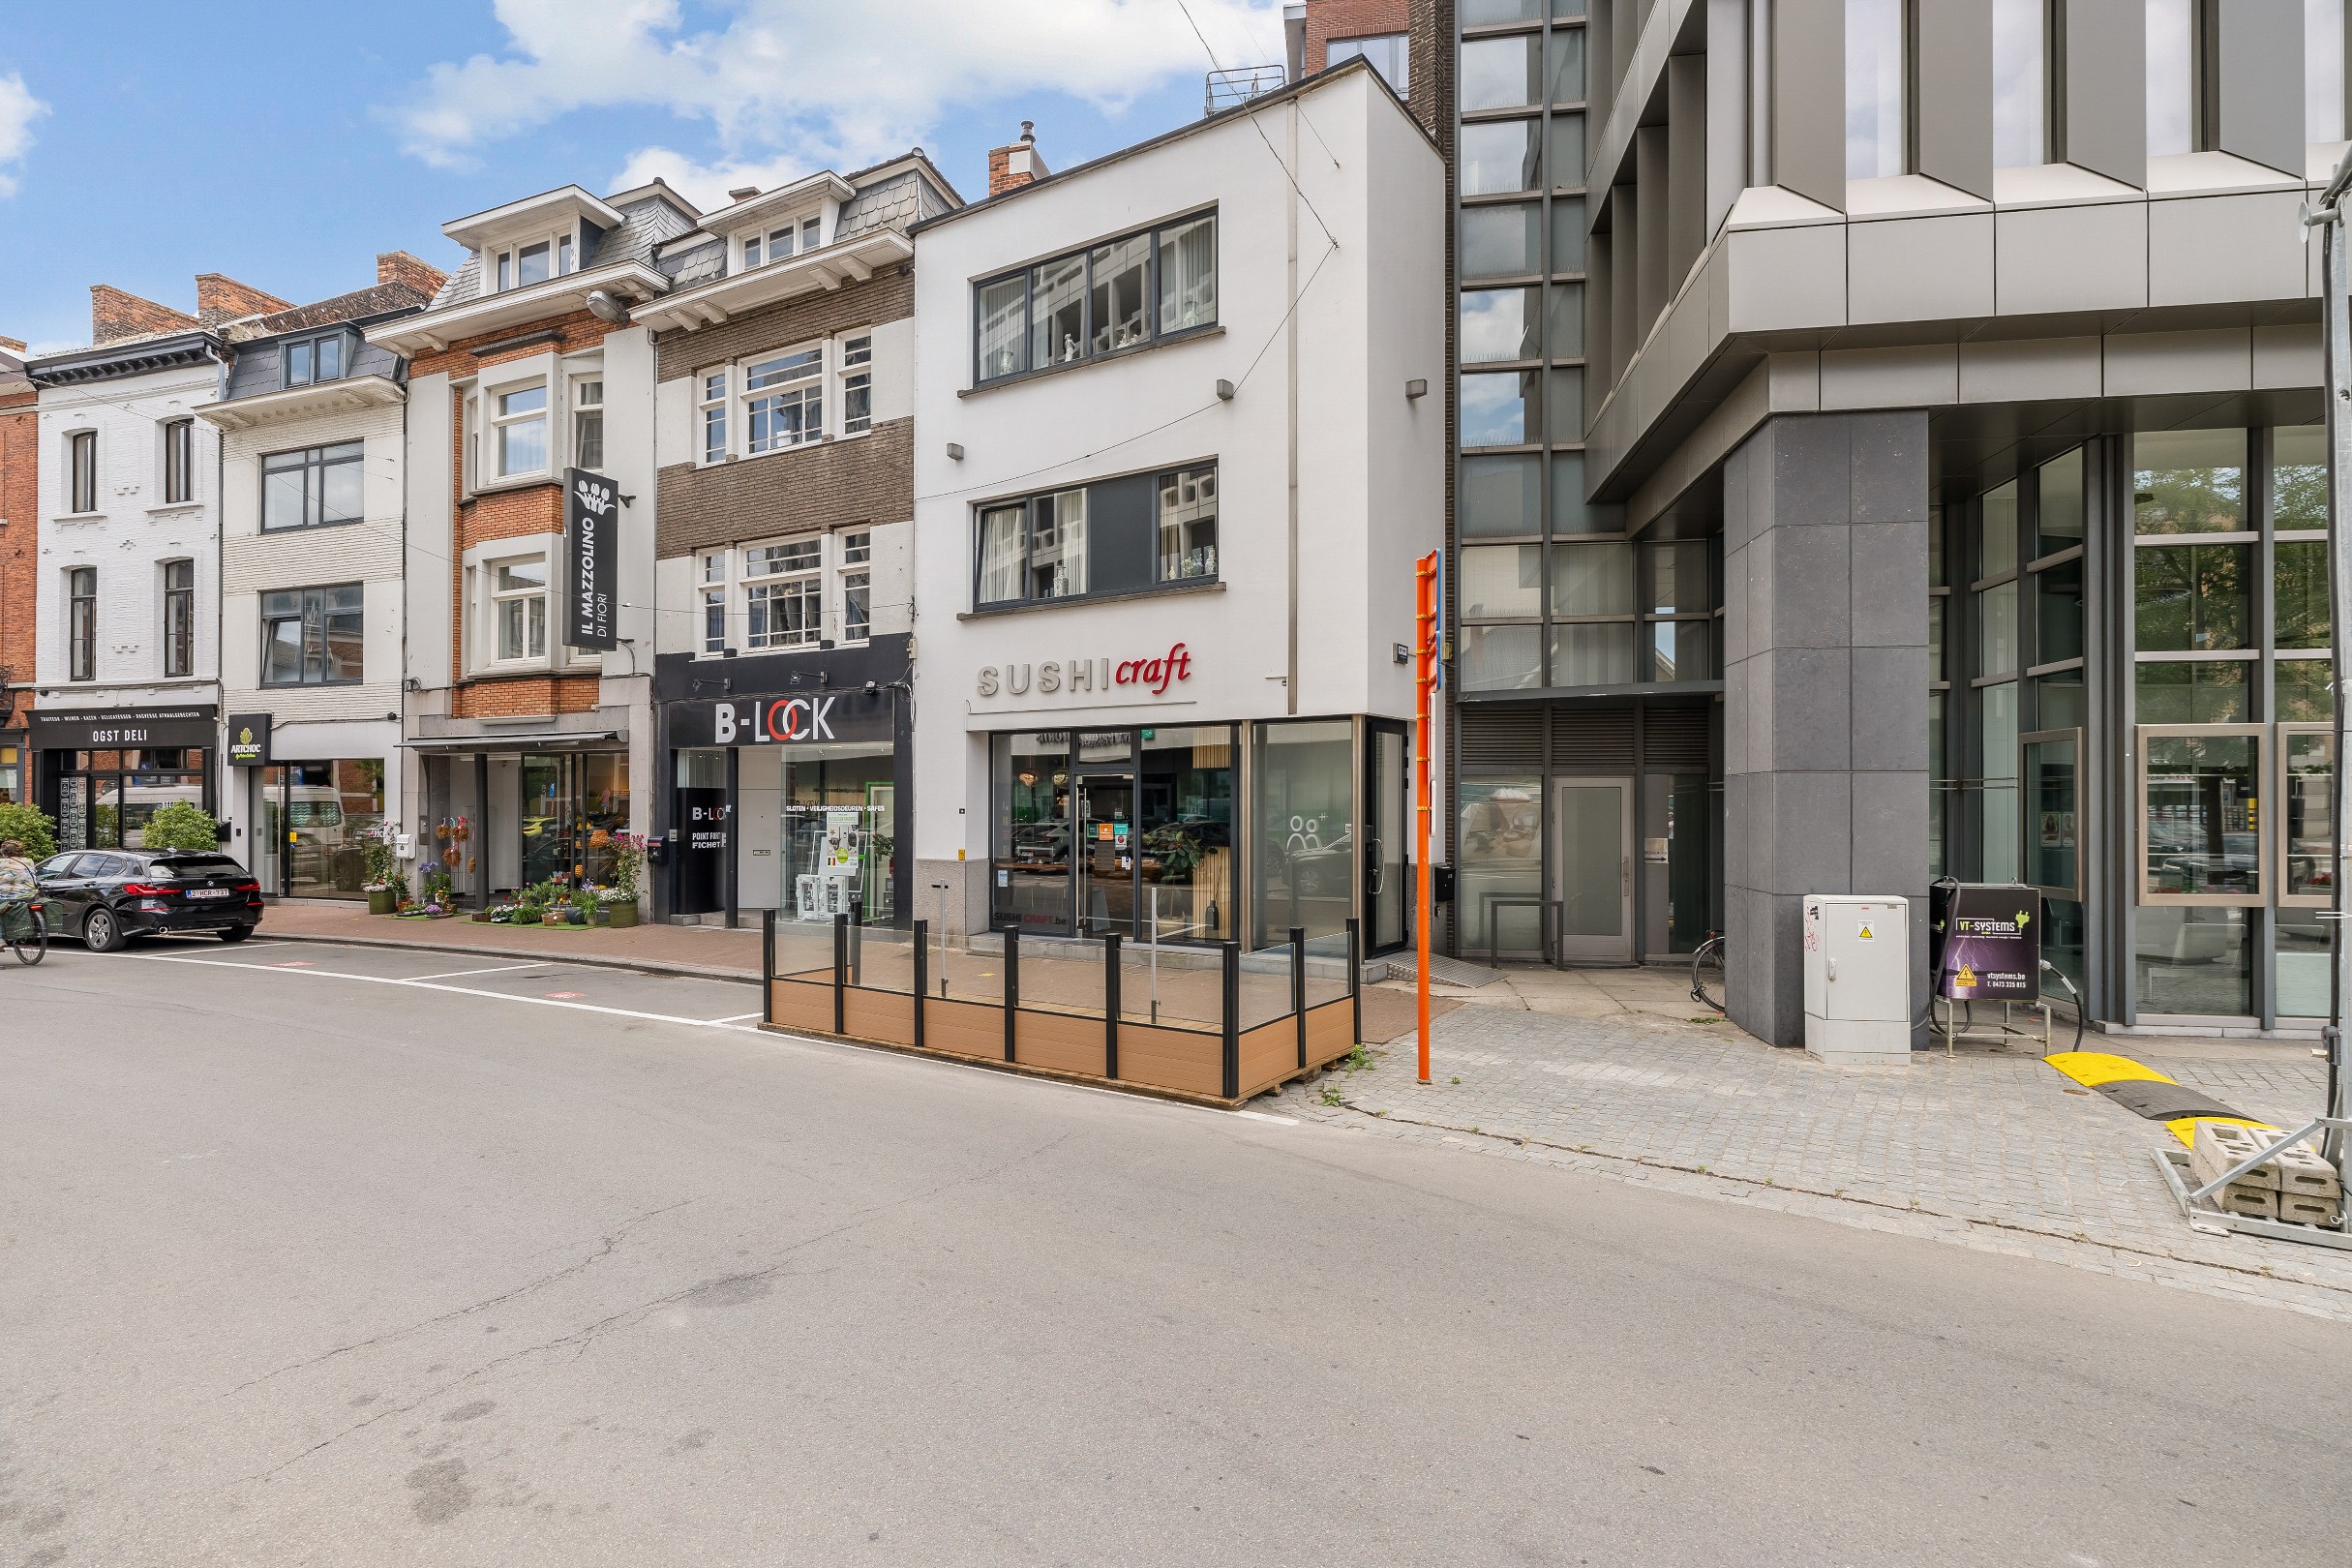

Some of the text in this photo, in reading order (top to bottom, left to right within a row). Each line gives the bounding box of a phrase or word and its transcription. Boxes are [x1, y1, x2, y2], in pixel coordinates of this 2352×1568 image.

[581, 517, 594, 636] IL MAZZOLINO
[597, 593, 608, 638] DI FIORI
[977, 642, 1191, 696] SUSHI craft
[715, 696, 836, 744] B-LOCK
[93, 729, 147, 742] OGST DELI
[230, 743, 261, 754] ARTCHOC
[692, 832, 709, 841] POINT
[993, 912, 1022, 922] SUSHI
[1959, 920, 2015, 932] VT-SYSTEMS
[1986, 972, 2026, 981] vtsystems.be
